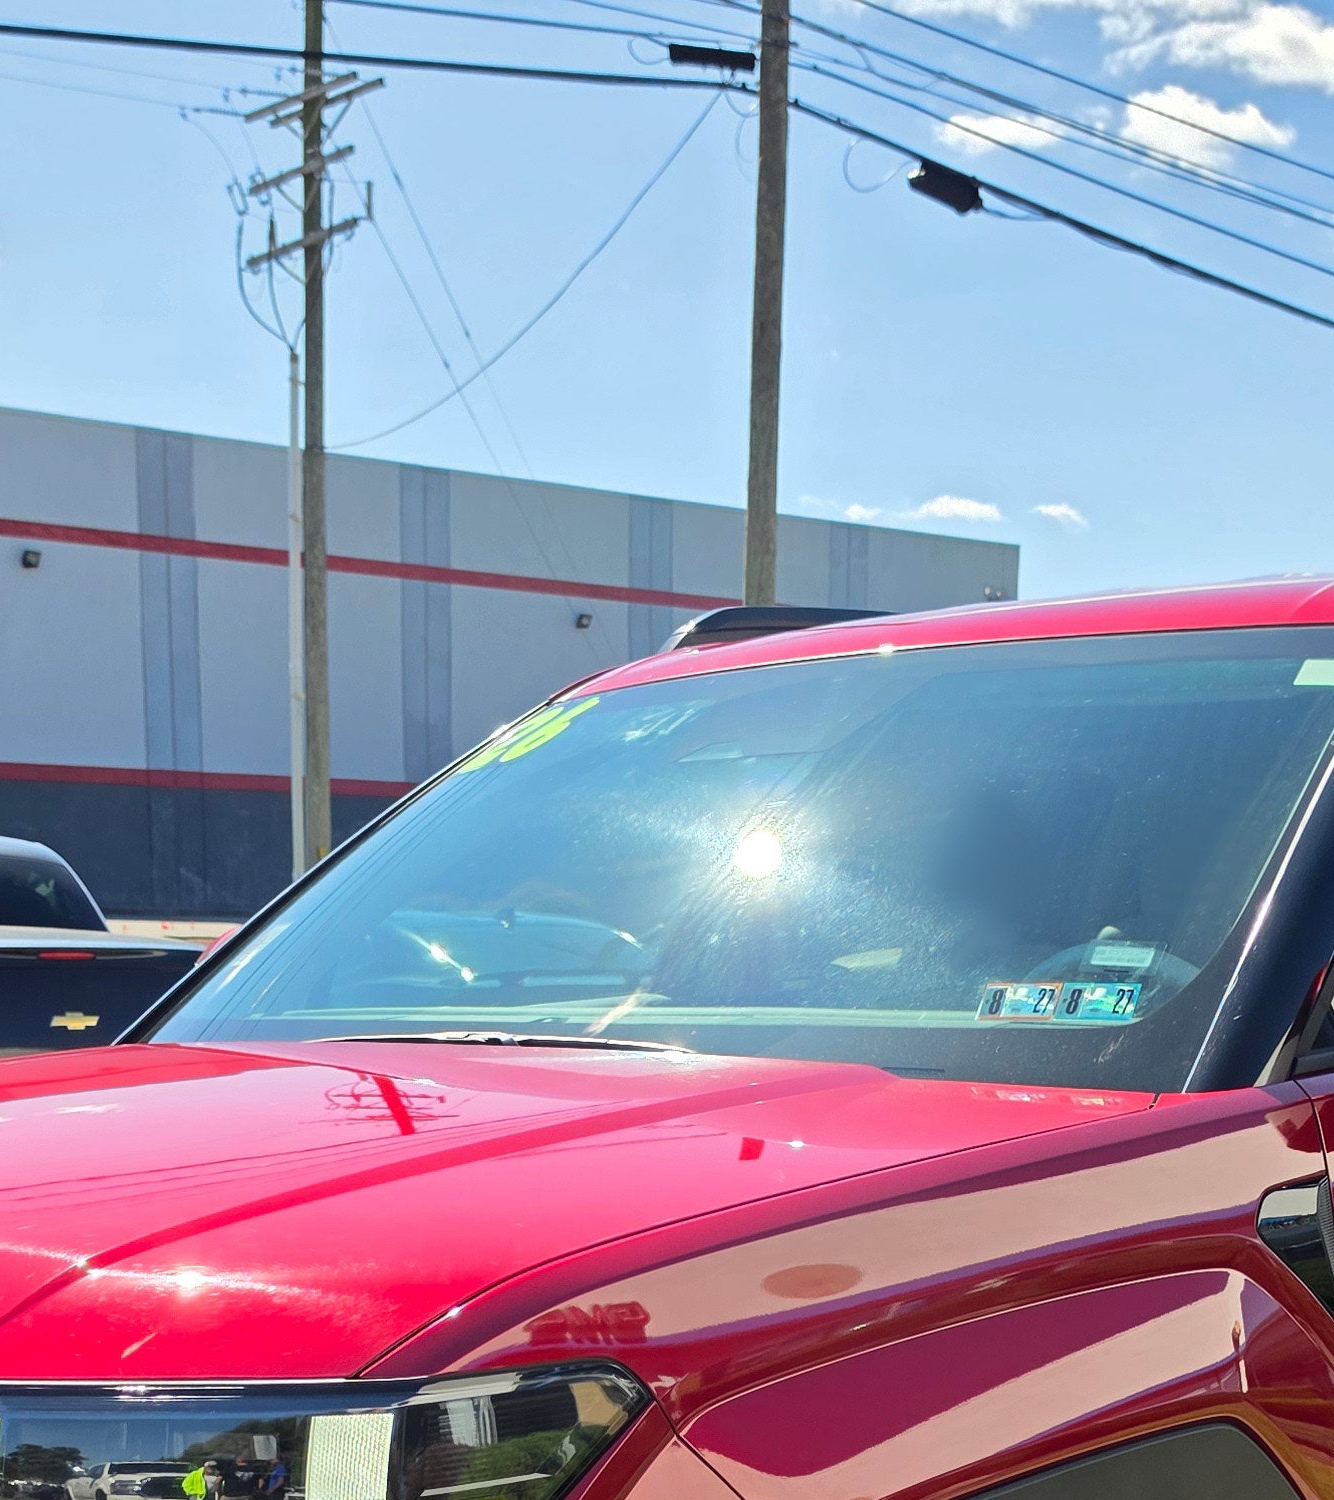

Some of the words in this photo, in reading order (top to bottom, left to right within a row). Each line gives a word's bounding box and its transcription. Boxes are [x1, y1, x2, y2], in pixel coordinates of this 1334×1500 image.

[988, 989, 1005, 1015] 8
[1032, 988, 1055, 1014] 27
[1065, 988, 1082, 1014] 8
[1111, 988, 1134, 1014] 27
